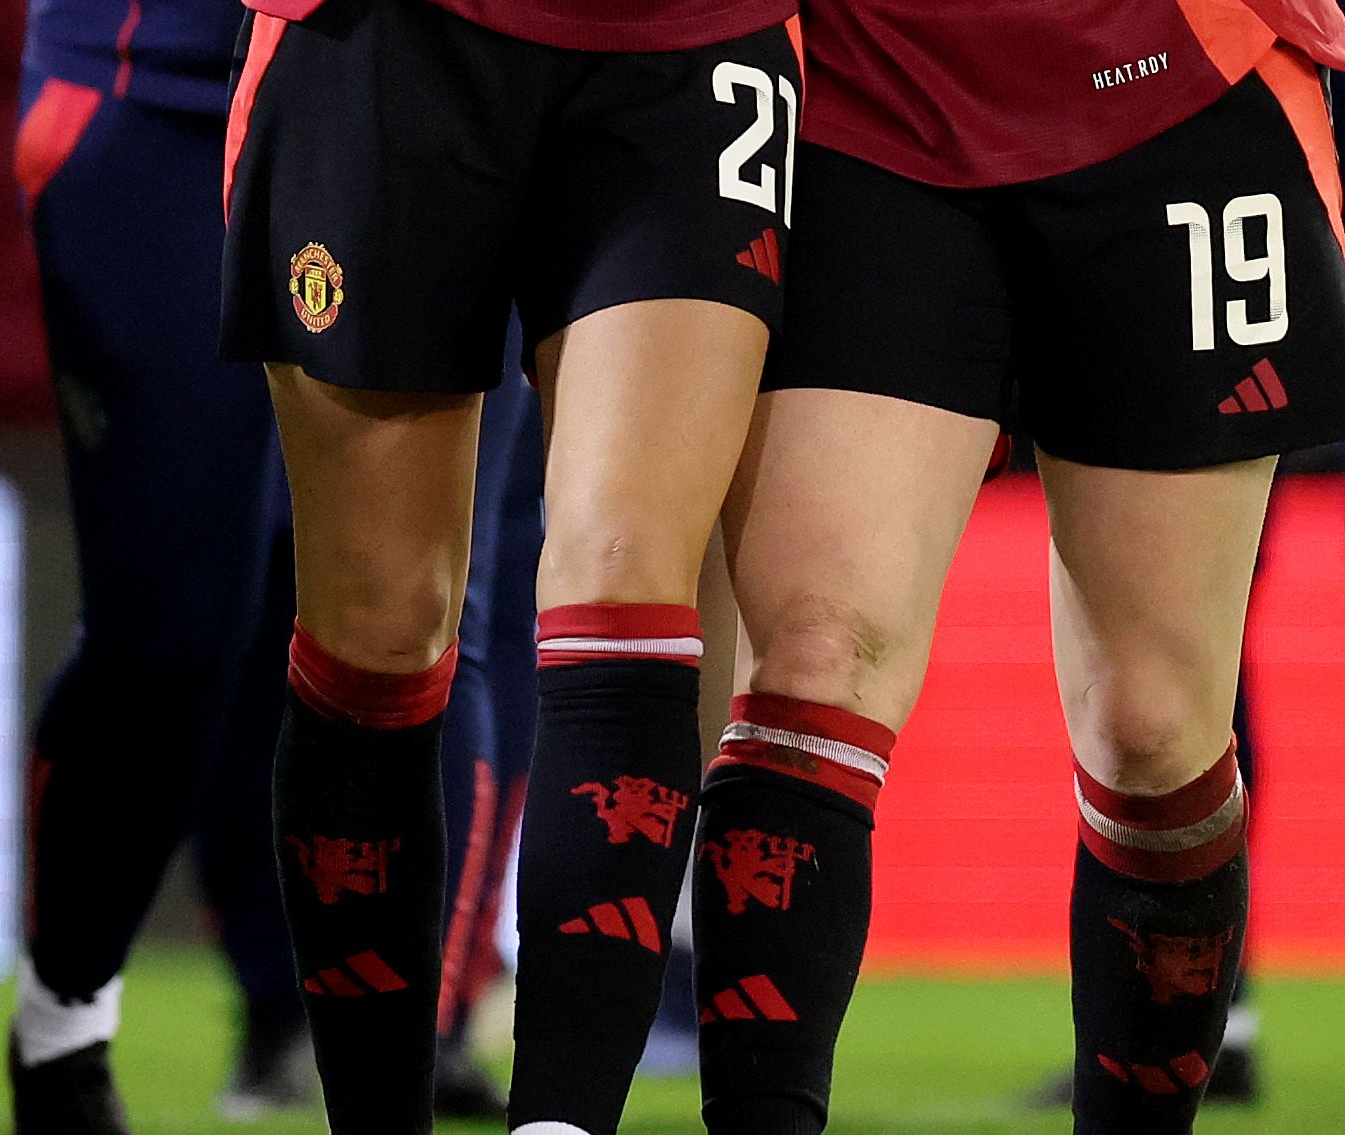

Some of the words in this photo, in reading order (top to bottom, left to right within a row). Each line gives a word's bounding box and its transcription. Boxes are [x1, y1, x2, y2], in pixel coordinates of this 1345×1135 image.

[1092, 51, 1168, 90] HEAT.RDY
[712, 61, 797, 230] 21
[294, 248, 340, 282] MANCHESTER
[1166, 193, 1289, 351] 19
[301, 308, 331, 327] UNITED
